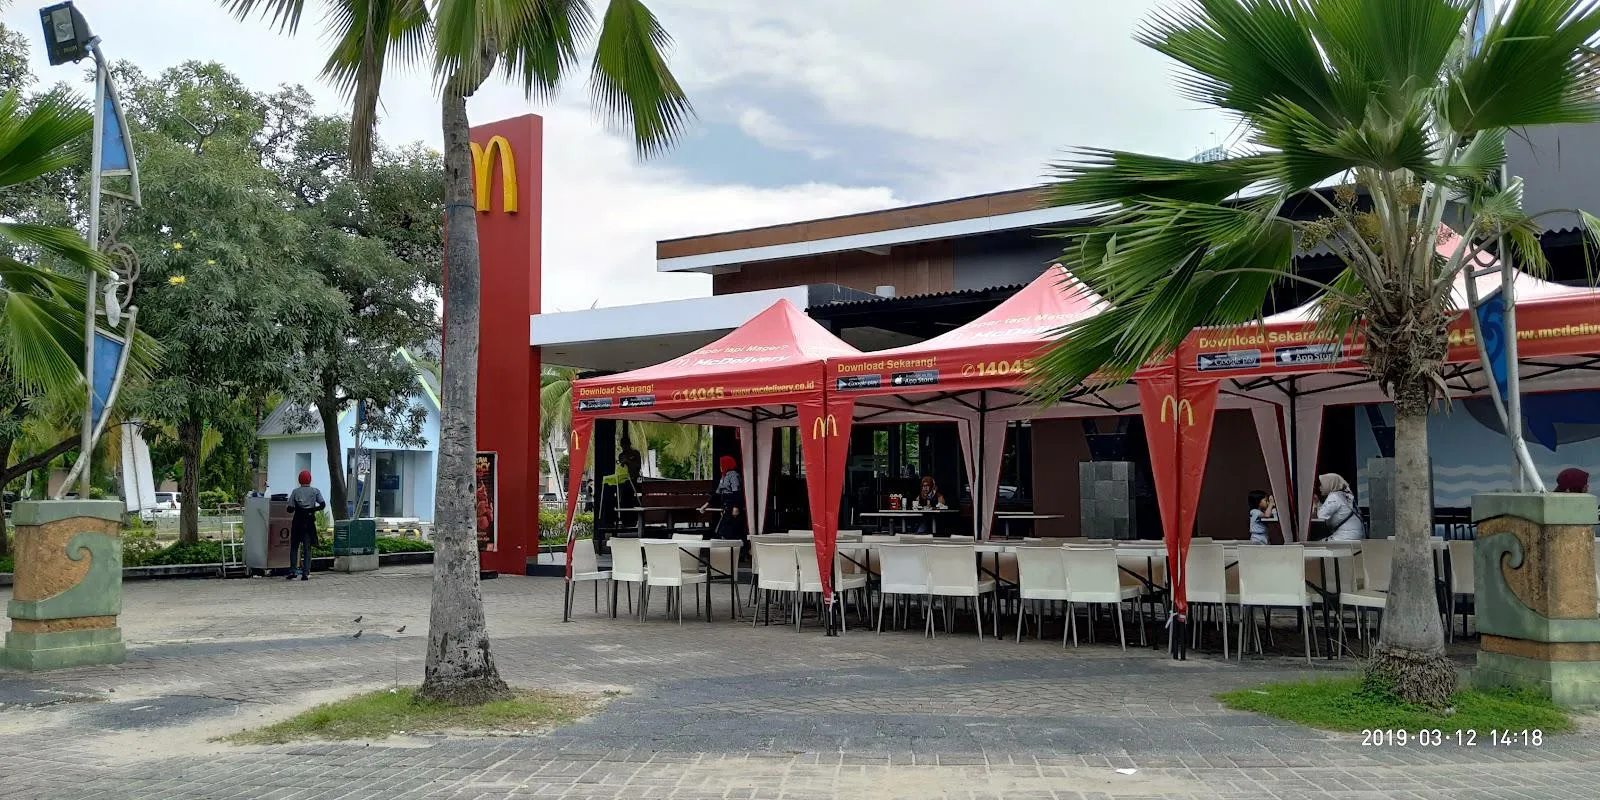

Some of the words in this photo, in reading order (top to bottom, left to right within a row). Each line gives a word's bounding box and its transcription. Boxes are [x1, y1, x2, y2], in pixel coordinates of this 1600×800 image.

[1200, 334, 1264, 349] Download
[1268, 329, 1336, 343] Sekarang
[837, 361, 884, 373] Download
[887, 356, 937, 369] Sekarang!
[579, 386, 615, 396] Download
[617, 383, 654, 394] Sekarang!
[682, 387, 725, 401] 14045
[730, 380, 815, 396] www.mcdelivery.co.id
